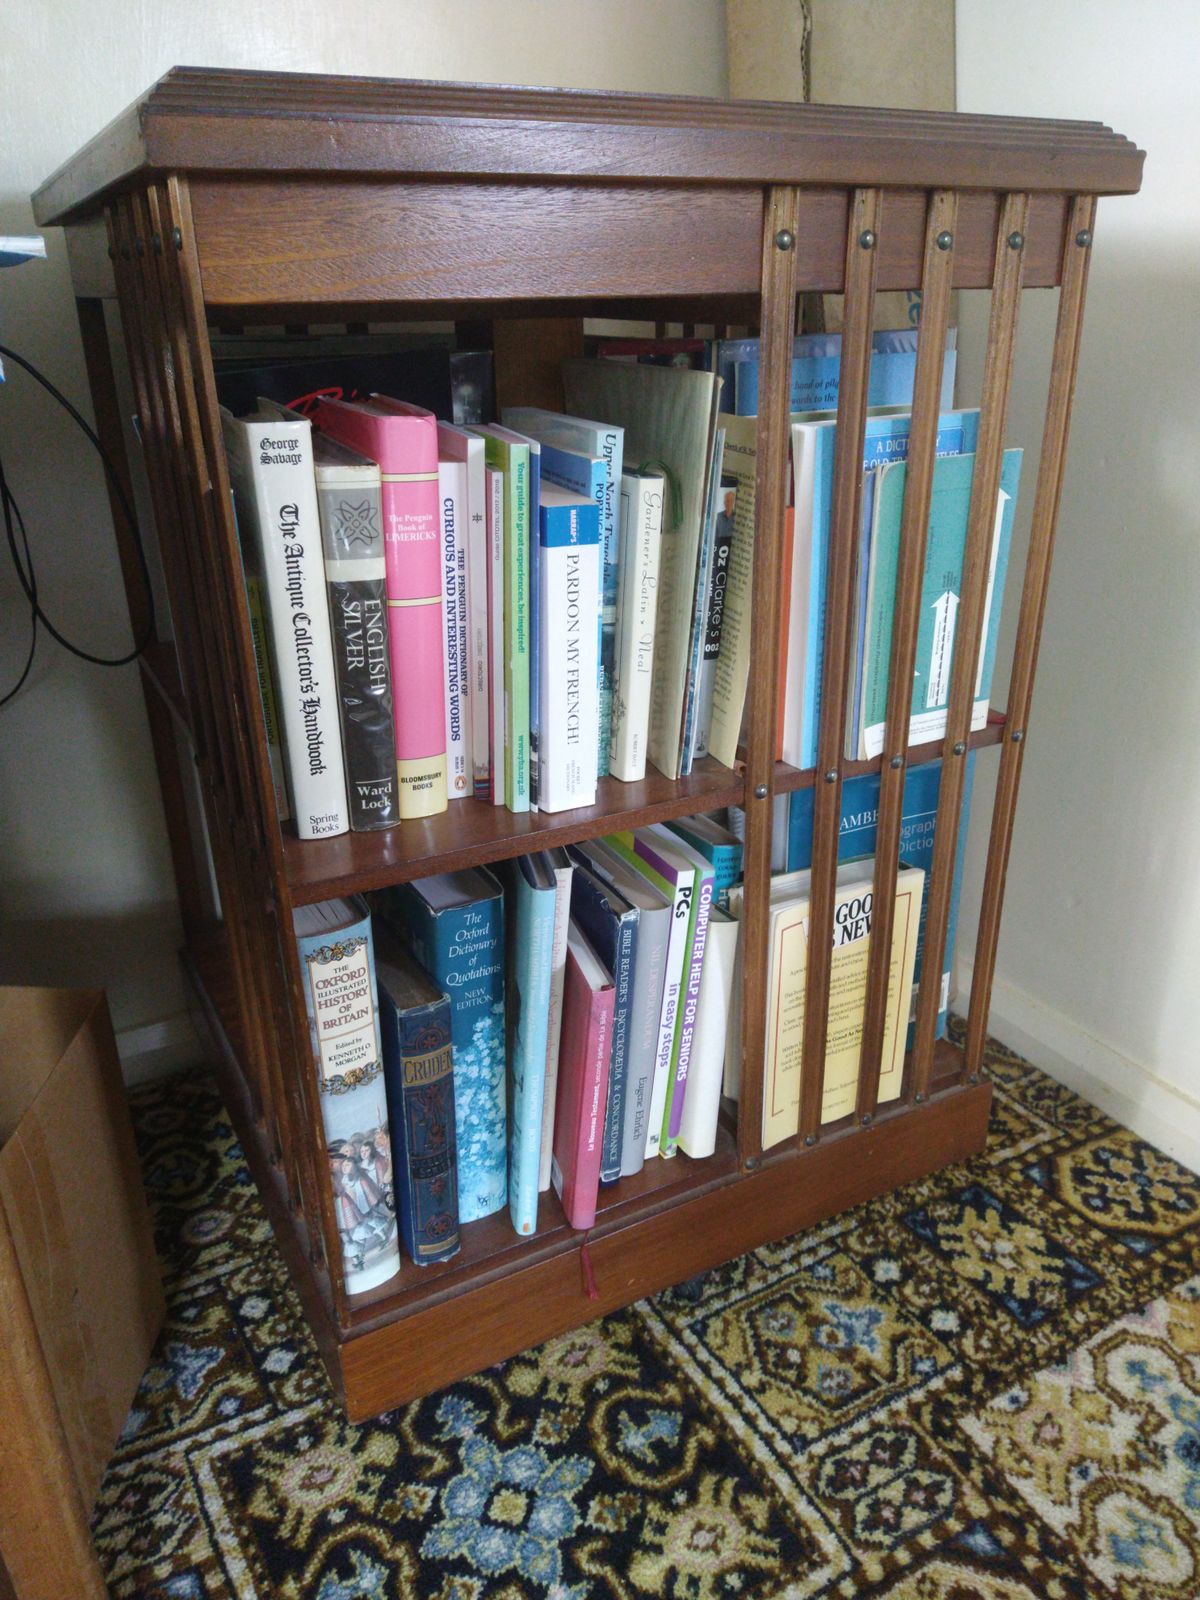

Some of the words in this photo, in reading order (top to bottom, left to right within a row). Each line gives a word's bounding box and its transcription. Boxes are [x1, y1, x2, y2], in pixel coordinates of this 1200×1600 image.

[260, 438, 298, 451] George
[603, 434, 616, 477] Upper
[876, 442, 883, 453] A
[260, 452, 302, 465] Savage
[517, 462, 525, 484] Your
[516, 485, 525, 511] guide
[605, 481, 615, 519] North
[278, 503, 300, 540] The
[389, 513, 404, 523] The
[405, 513, 433, 523] Penguin
[398, 523, 416, 531] Book
[418, 523, 426, 531] of
[517, 512, 525, 522] to
[643, 490, 661, 567] Gardener's
[386, 531, 437, 542] LIMERICKS
[443, 497, 456, 562] CURIOUS
[516, 523, 525, 546] great
[717, 545, 729, 566] Oz
[284, 544, 306, 609] Antique
[445, 565, 457, 596] AND
[516, 548, 525, 603] experiences,
[458, 575, 466, 622] PENGUIN
[567, 553, 580, 632] PARDON
[640, 570, 657, 613] Latin
[517, 604, 525, 615] be
[711, 571, 727, 637] Clarke's
[342, 598, 365, 670] SILVER
[364, 600, 386, 689] ENGLISH
[516, 616, 525, 653] inspired!
[292, 612, 319, 694] Collector's
[446, 599, 460, 696] INTERESTING
[459, 625, 468, 682] DICTIONARY
[567, 639, 580, 662] MY
[705, 643, 719, 652] 002
[461, 684, 468, 696] OF
[567, 669, 580, 745] FRENCH!
[450, 697, 460, 742] WORDS
[300, 697, 327, 776] Handbook
[401, 771, 442, 783] BLOOMSBURY
[412, 782, 433, 791] BOOKS
[357, 783, 392, 797] Ward
[361, 796, 392, 810] Lock
[309, 812, 339, 826] Spring
[311, 823, 339, 834] Books
[839, 809, 879, 830] AMBE
[900, 838, 933, 853] Dictio
[676, 886, 692, 919] PCs
[836, 893, 873, 925] GOO
[463, 912, 482, 926] The
[693, 884, 713, 959] COMPUTER
[455, 923, 490, 942] Oxford
[622, 929, 632, 955] BIBLE
[448, 937, 497, 958] Dictionary
[334, 964, 349, 974] THE
[468, 954, 478, 967] of
[315, 967, 366, 990] OXFORD
[446, 963, 501, 987] Quotations
[620, 958, 630, 1003] READER'S
[688, 962, 701, 995] HELP
[318, 978, 366, 999] ILLUSTRATED
[318, 985, 368, 1009] HISTORY
[464, 987, 486, 999] NEW
[669, 983, 680, 997] in
[338, 1003, 352, 1014] OF
[456, 995, 494, 1011] EDITION
[661, 999, 676, 1029] easy
[684, 999, 697, 1024] FOR
[323, 1006, 369, 1030] BRITAIN
[328, 1045, 364, 1062] KENNETH
[335, 1040, 354, 1050] Edited
[356, 1037, 363, 1046] by
[658, 1032, 673, 1068] steps
[677, 1027, 693, 1081] SENIORS
[335, 1052, 367, 1067] MORGAN
[635, 1076, 647, 1106] Eugene
[609, 1094, 621, 1162] CONCORDANCE
[633, 1110, 644, 1141] Ehrlich
